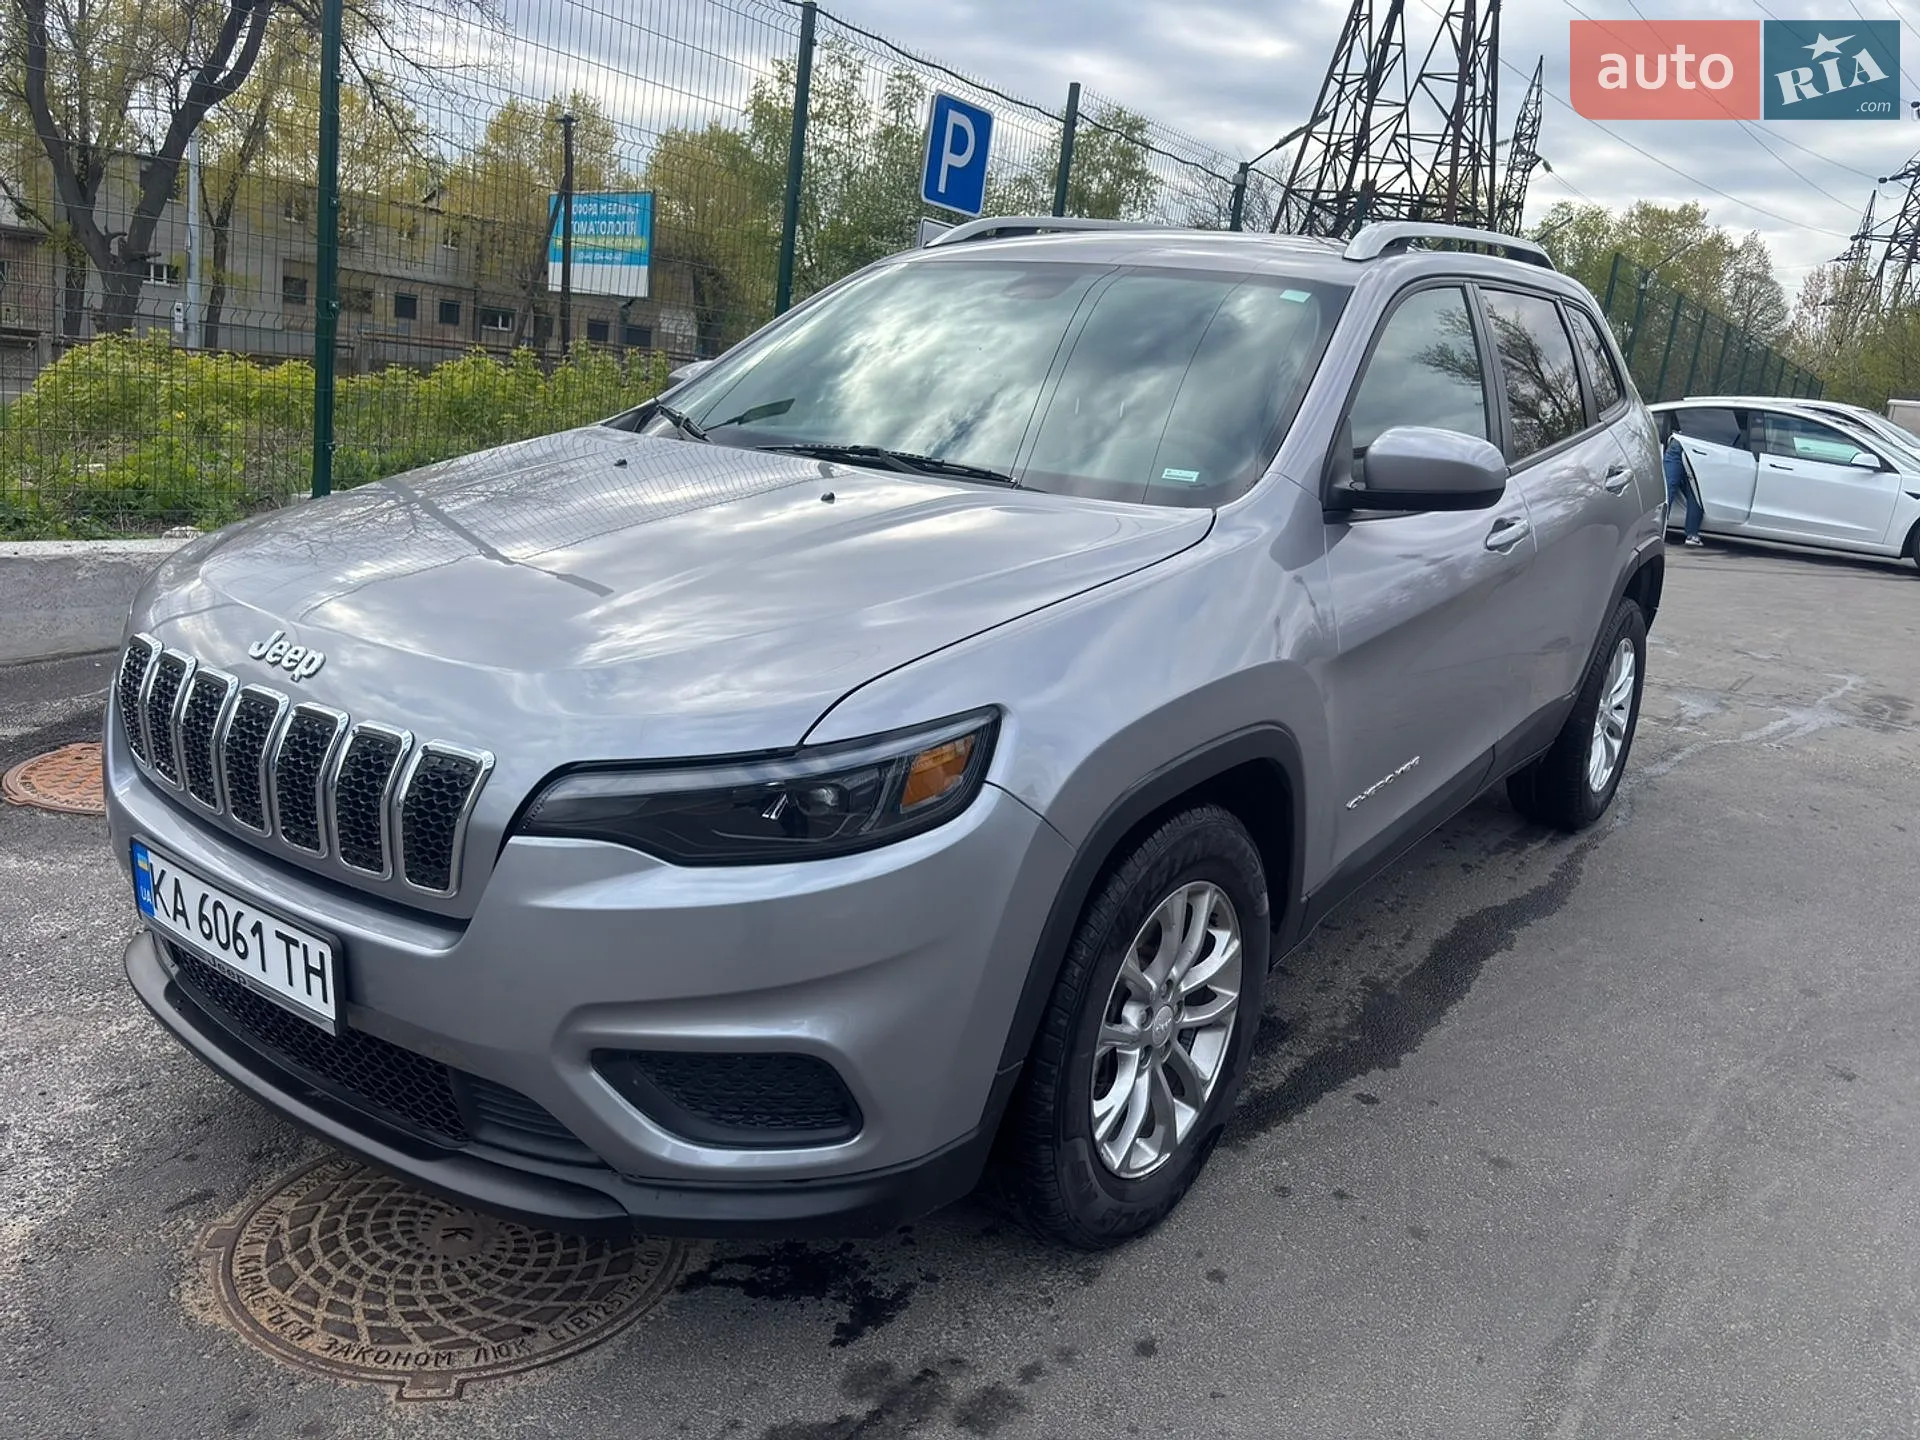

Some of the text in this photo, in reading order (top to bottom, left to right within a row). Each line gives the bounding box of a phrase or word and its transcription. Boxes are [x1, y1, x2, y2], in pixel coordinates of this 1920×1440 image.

[937, 108, 976, 194] P
[248, 630, 325, 682] Jeep
[140, 885, 153, 904] UA
[150, 862, 329, 1004] KA 6061 TH
[206, 956, 248, 987] Jeep
[319, 1335, 453, 1368] ЗАКОНОМ
[473, 1338, 533, 1364] ЛЮК
